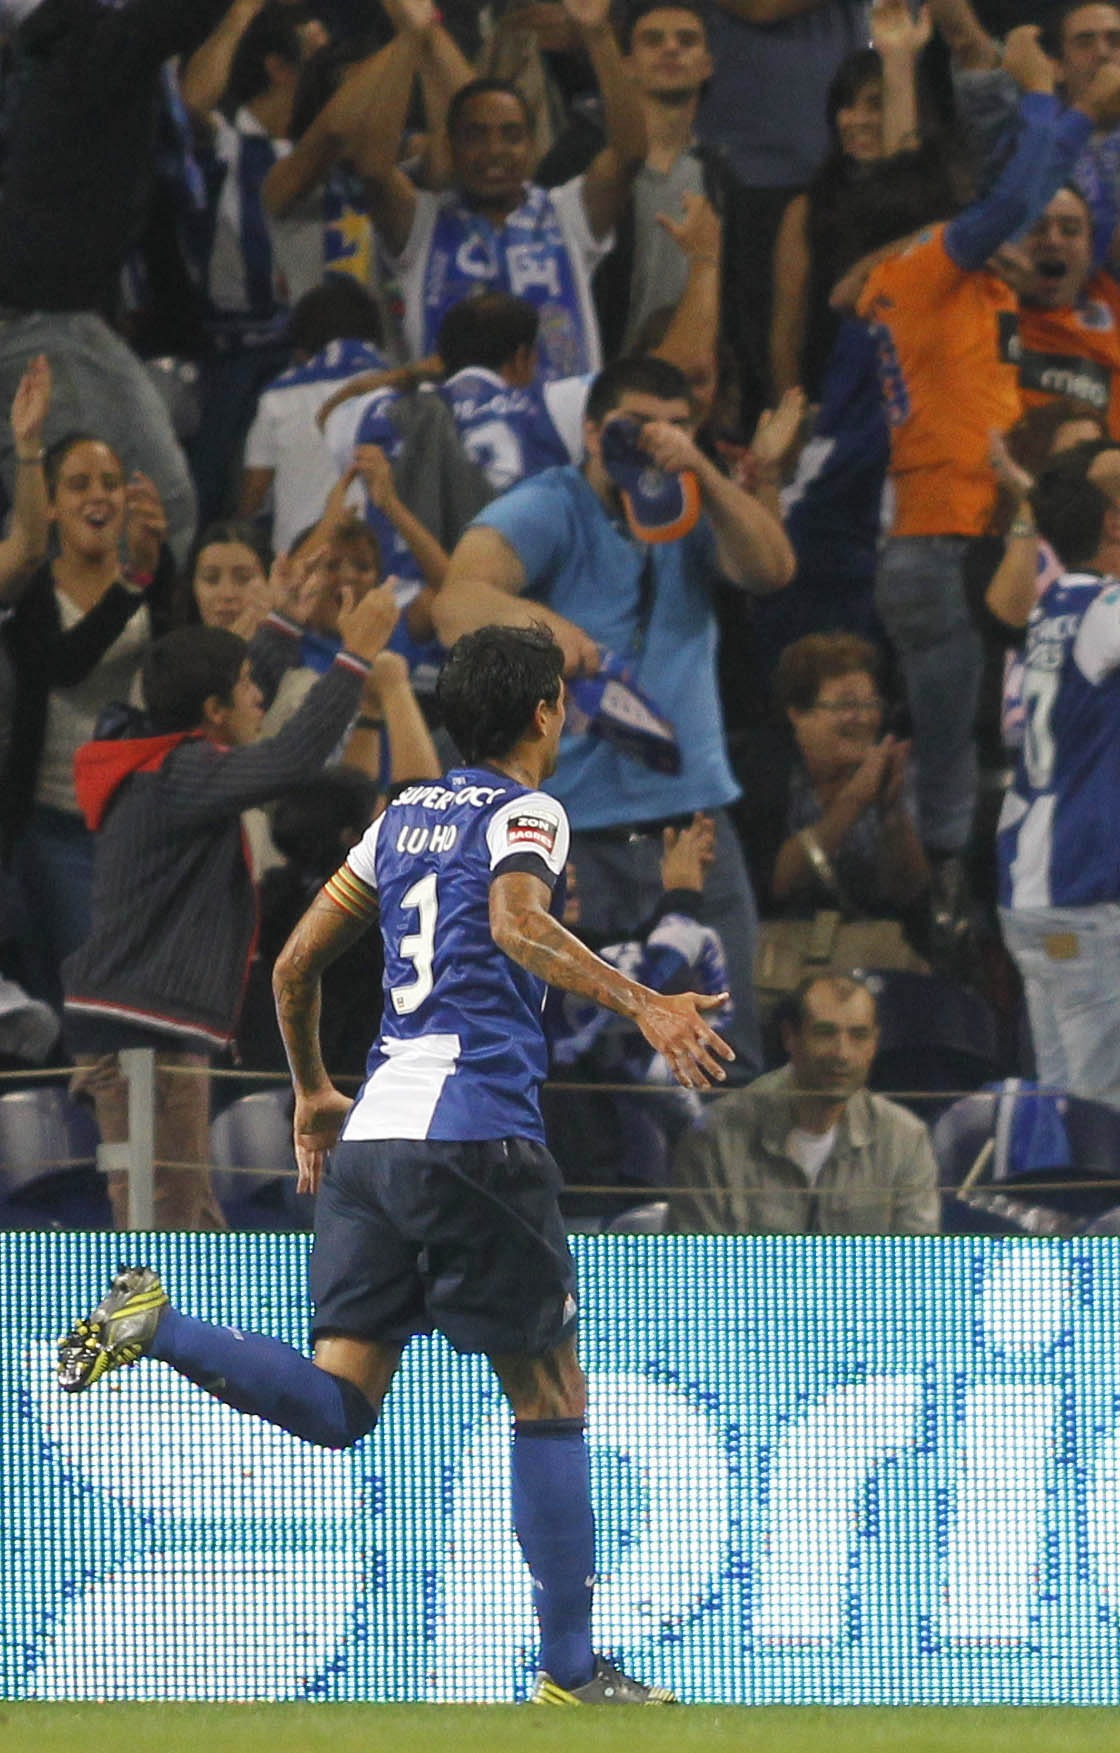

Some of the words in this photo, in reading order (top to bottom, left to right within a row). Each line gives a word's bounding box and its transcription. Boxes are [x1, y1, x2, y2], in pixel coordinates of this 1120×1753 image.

[396, 824, 457, 854] LUHO
[517, 817, 550, 832] ZON
[391, 873, 438, 1015] 3
